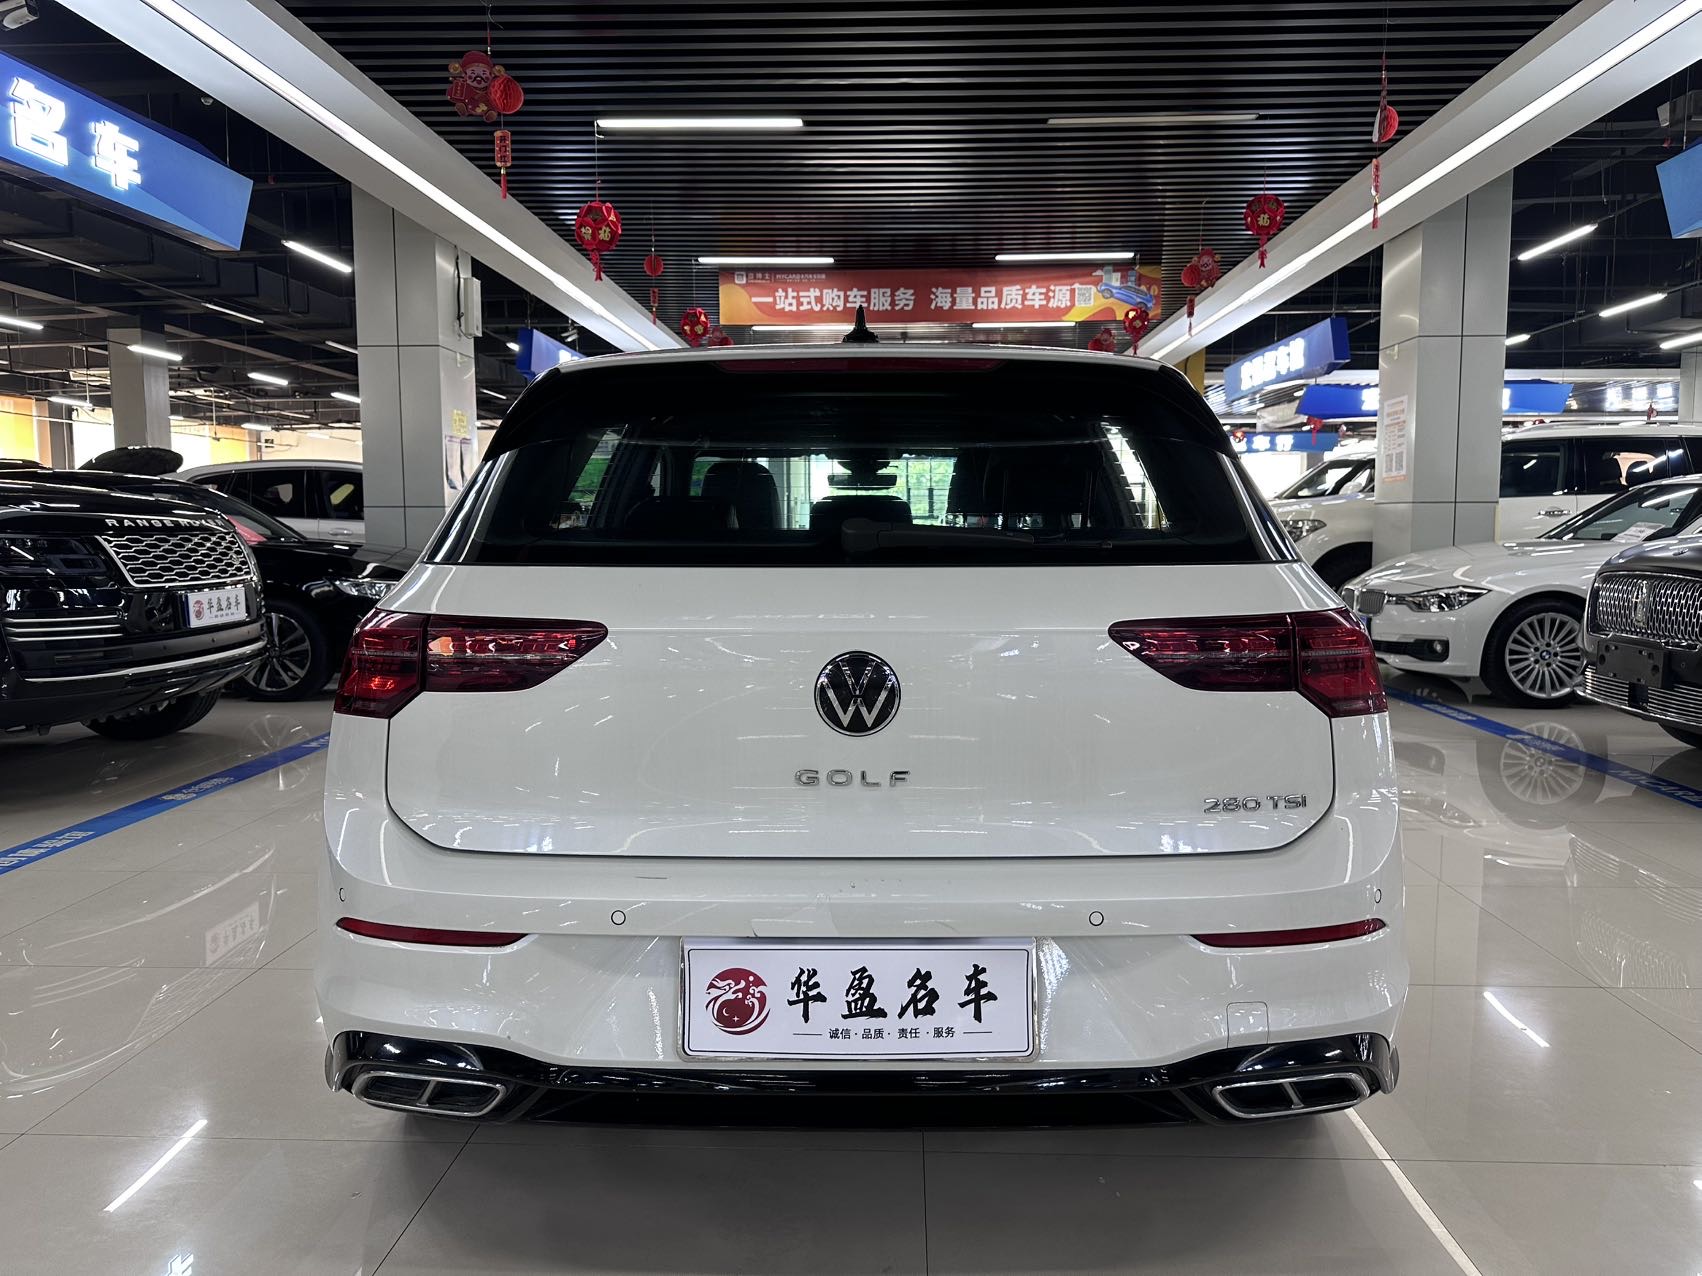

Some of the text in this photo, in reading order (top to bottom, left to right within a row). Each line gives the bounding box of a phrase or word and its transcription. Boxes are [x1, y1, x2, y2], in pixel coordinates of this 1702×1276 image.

[751, 284, 1071, 311] 一站式购车服务 海量品质车源
[105, 518, 175, 528] RANGE
[794, 769, 911, 787] GOLF
[1203, 794, 1307, 813] 280 TSI
[786, 963, 998, 1024] 华盈名车
